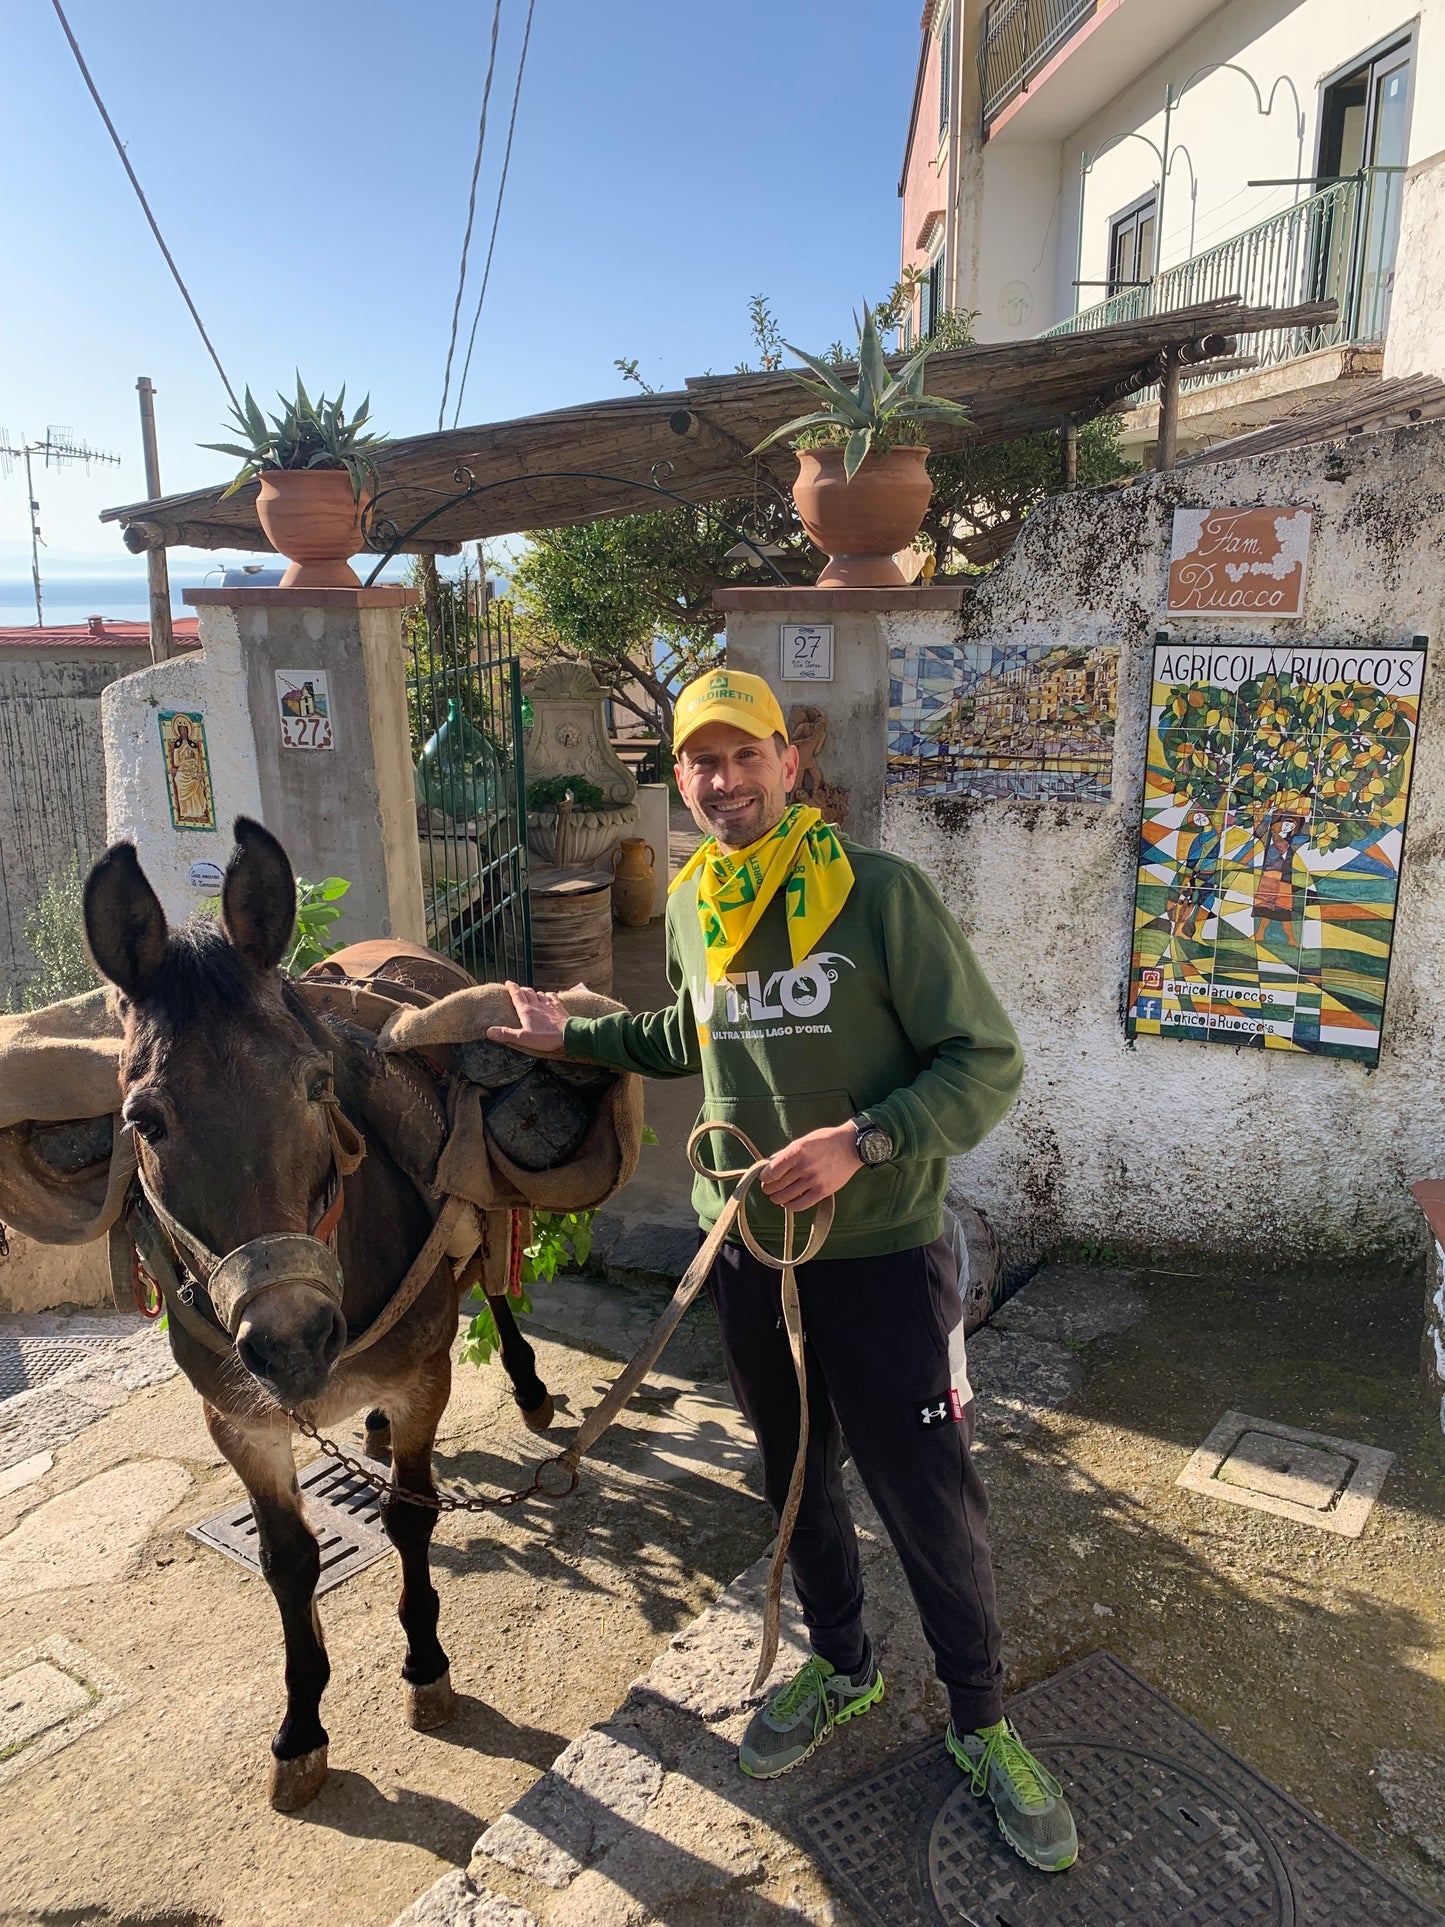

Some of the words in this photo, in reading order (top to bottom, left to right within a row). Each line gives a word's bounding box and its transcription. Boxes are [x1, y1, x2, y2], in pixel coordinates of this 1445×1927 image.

[1199, 510, 1263, 556] Fam.
[1170, 563, 1286, 609] Ruocco
[794, 635, 821, 658] 27
[1159, 654, 1279, 684] AGRICOLA
[1290, 656, 1415, 687] RUOCCO'S
[294, 718, 320, 746] 27
[712, 1030, 740, 1040] ULTRA
[740, 1029, 764, 1040] TRAIL
[766, 1025, 793, 1037] LAGO
[795, 1024, 833, 1035] D'ORTA
